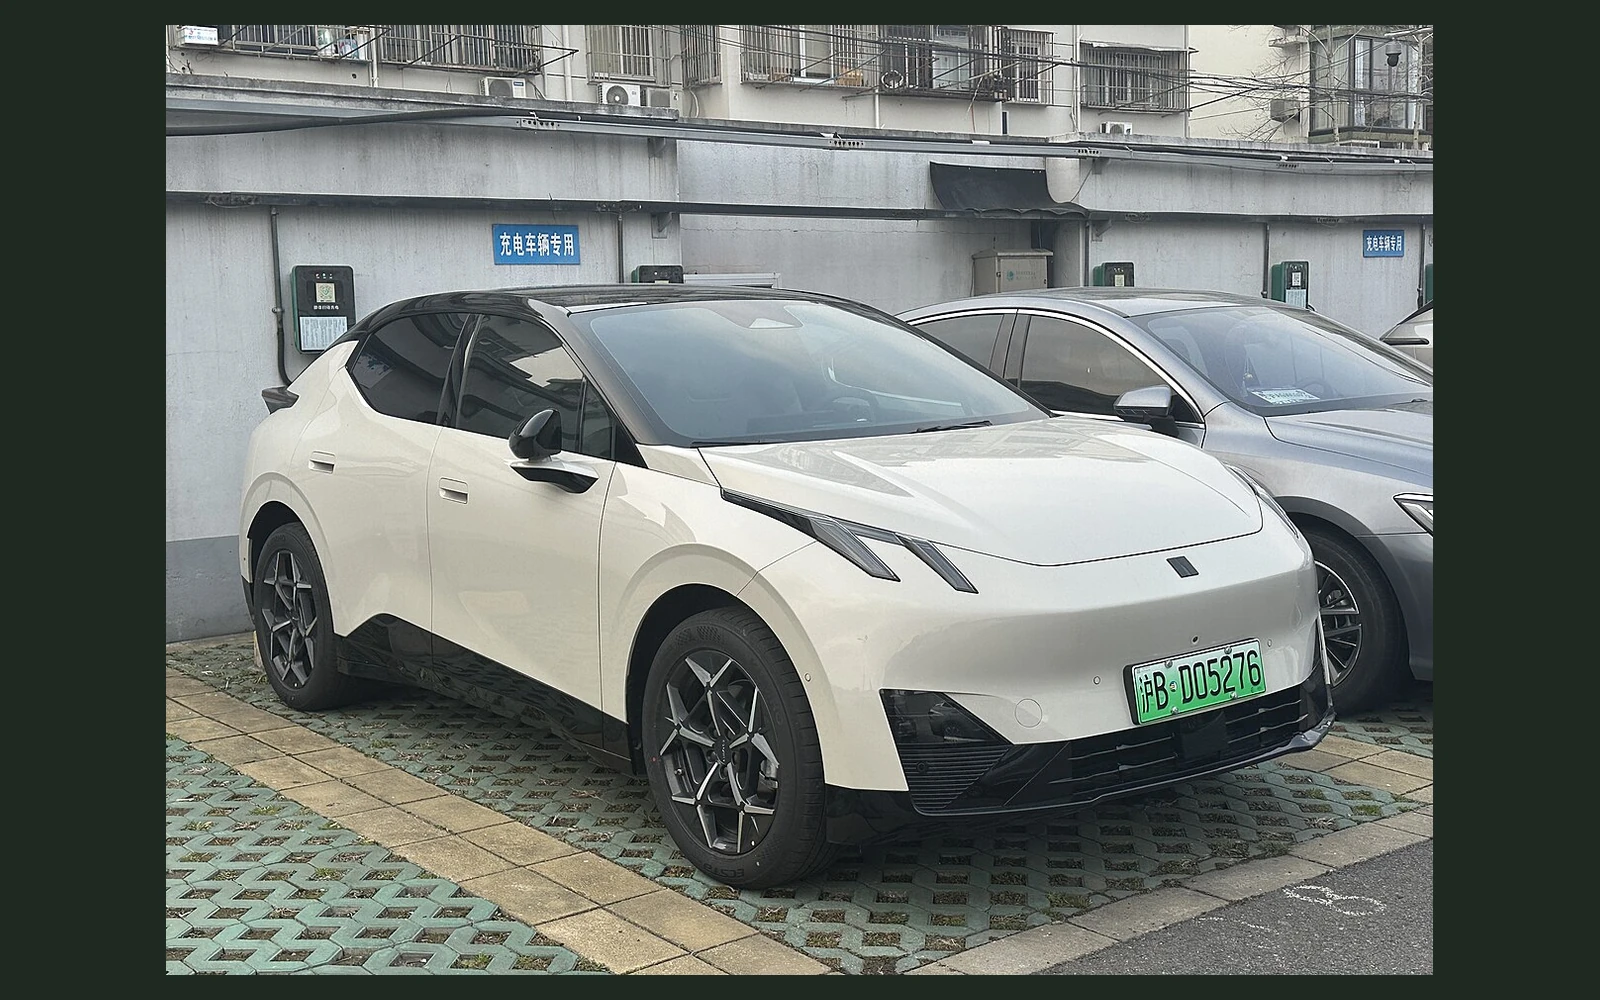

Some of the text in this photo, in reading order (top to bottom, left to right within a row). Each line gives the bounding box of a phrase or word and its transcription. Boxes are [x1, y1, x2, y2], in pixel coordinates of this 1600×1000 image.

[499, 232, 574, 257] 充电车辆专用
[1366, 235, 1402, 251] 充电车辆专用
